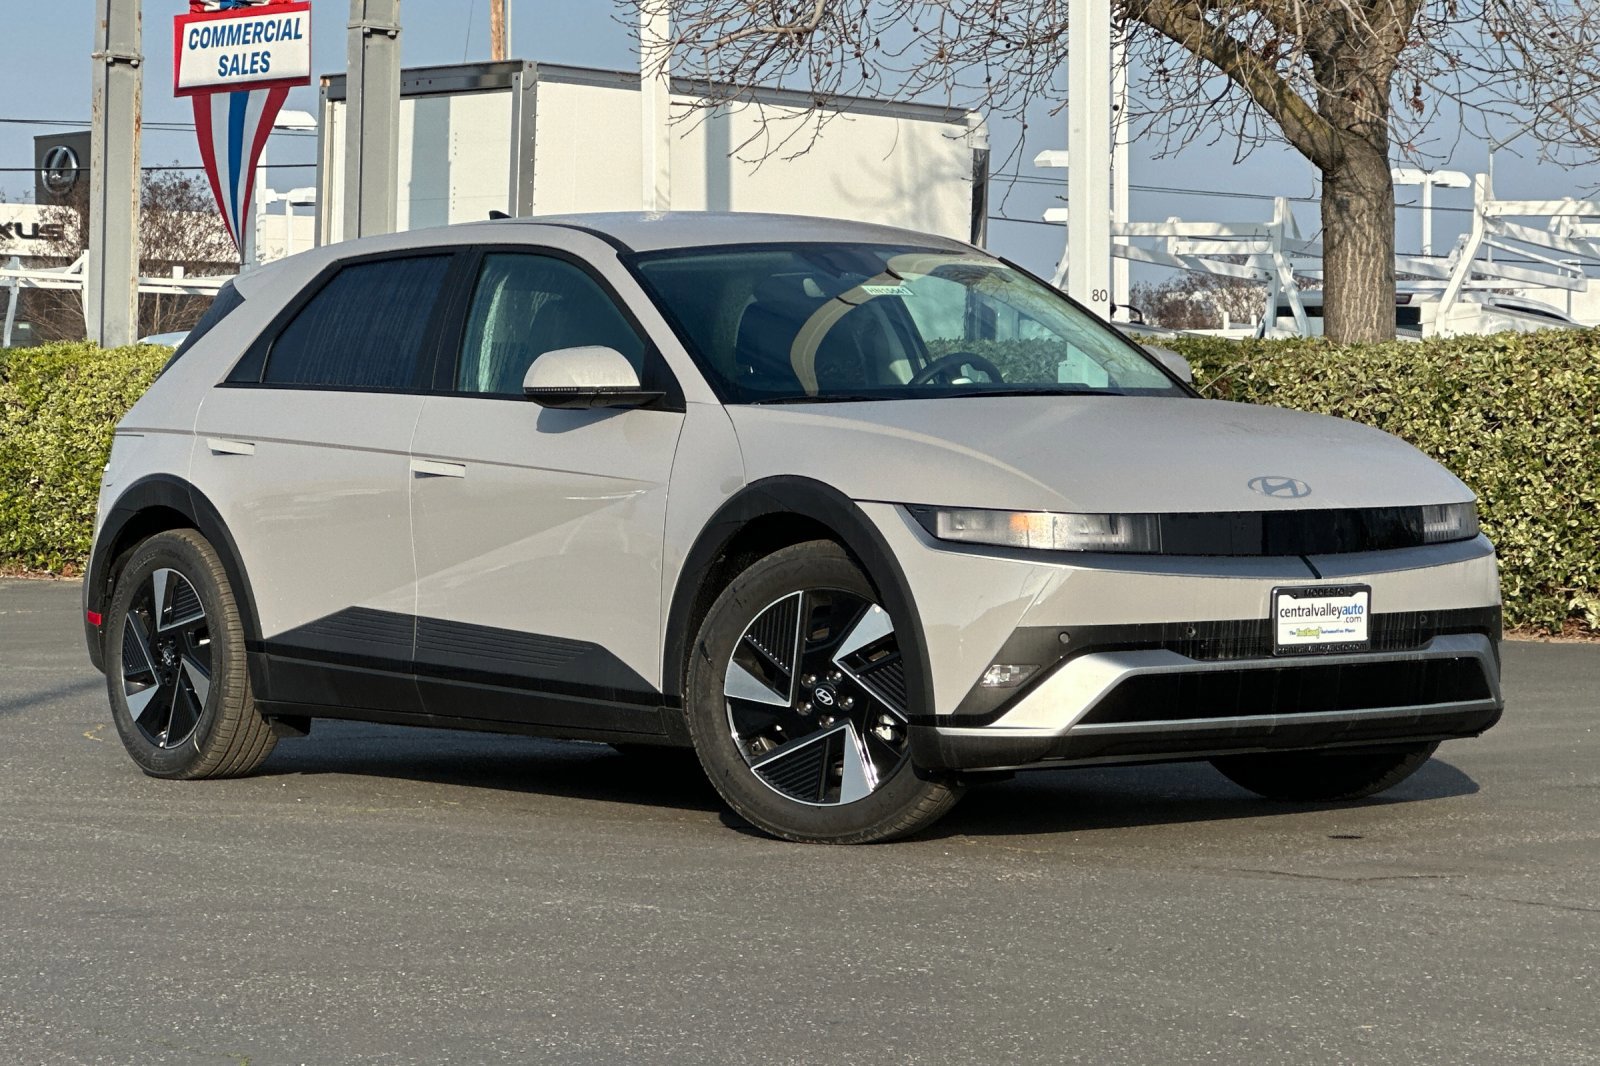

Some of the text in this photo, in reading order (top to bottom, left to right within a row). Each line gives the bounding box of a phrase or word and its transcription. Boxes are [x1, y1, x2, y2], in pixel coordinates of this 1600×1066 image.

[188, 17, 303, 50] COMMERCIAL
[217, 50, 271, 77] SALES
[1091, 288, 1108, 302] 80
[1303, 587, 1345, 597] MODESTO
